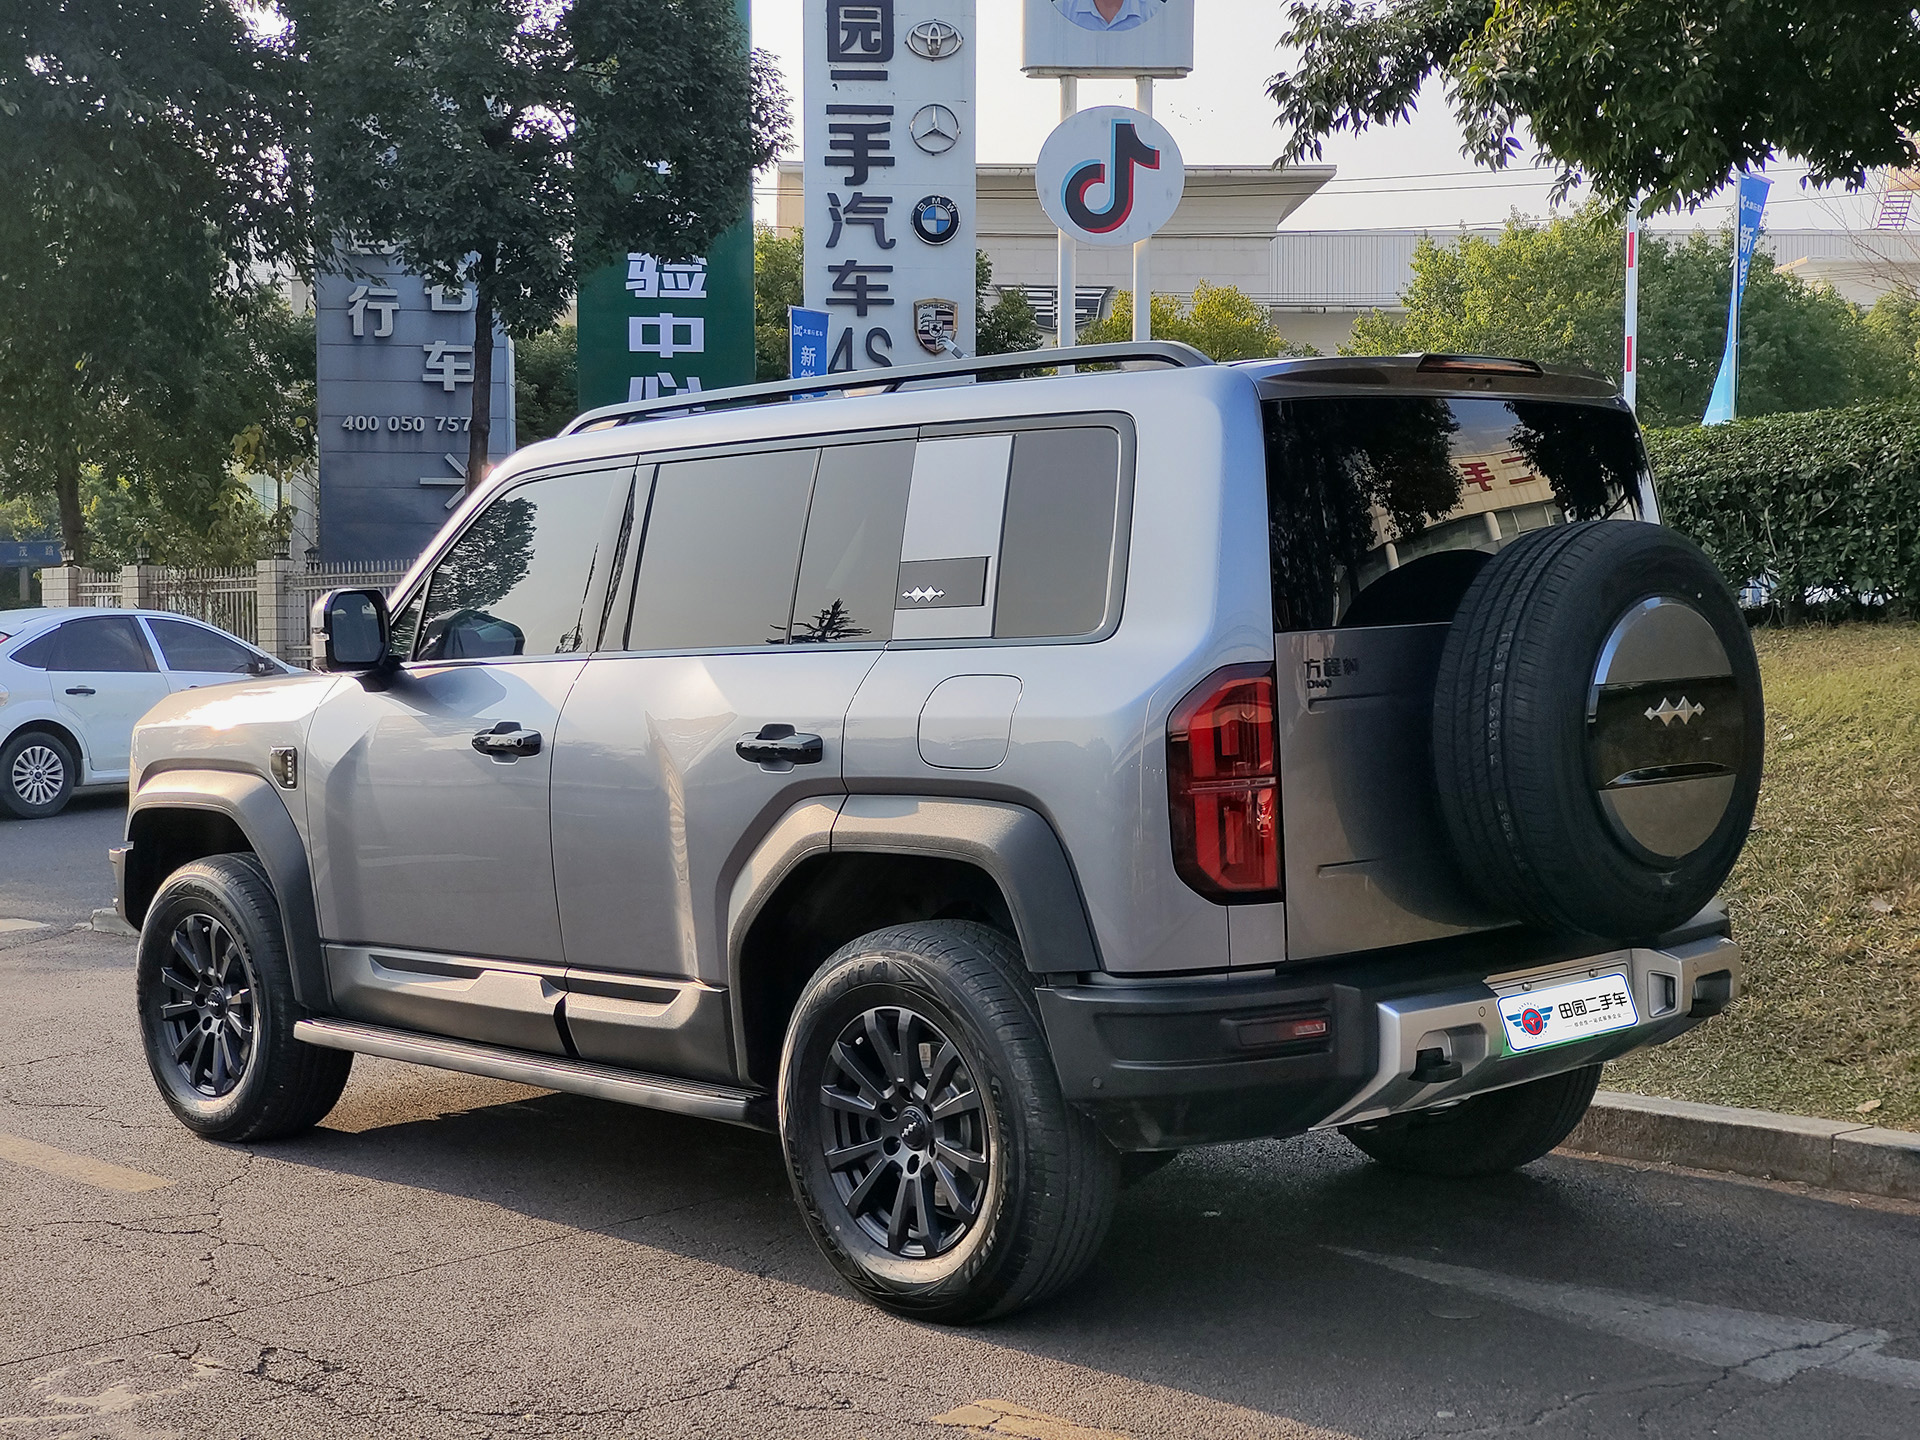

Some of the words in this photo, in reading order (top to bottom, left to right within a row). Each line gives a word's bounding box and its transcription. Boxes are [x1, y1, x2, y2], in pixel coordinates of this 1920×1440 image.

[917, 197, 957, 213] BMW
[342, 415, 380, 432] 400
[387, 416, 425, 432] 050
